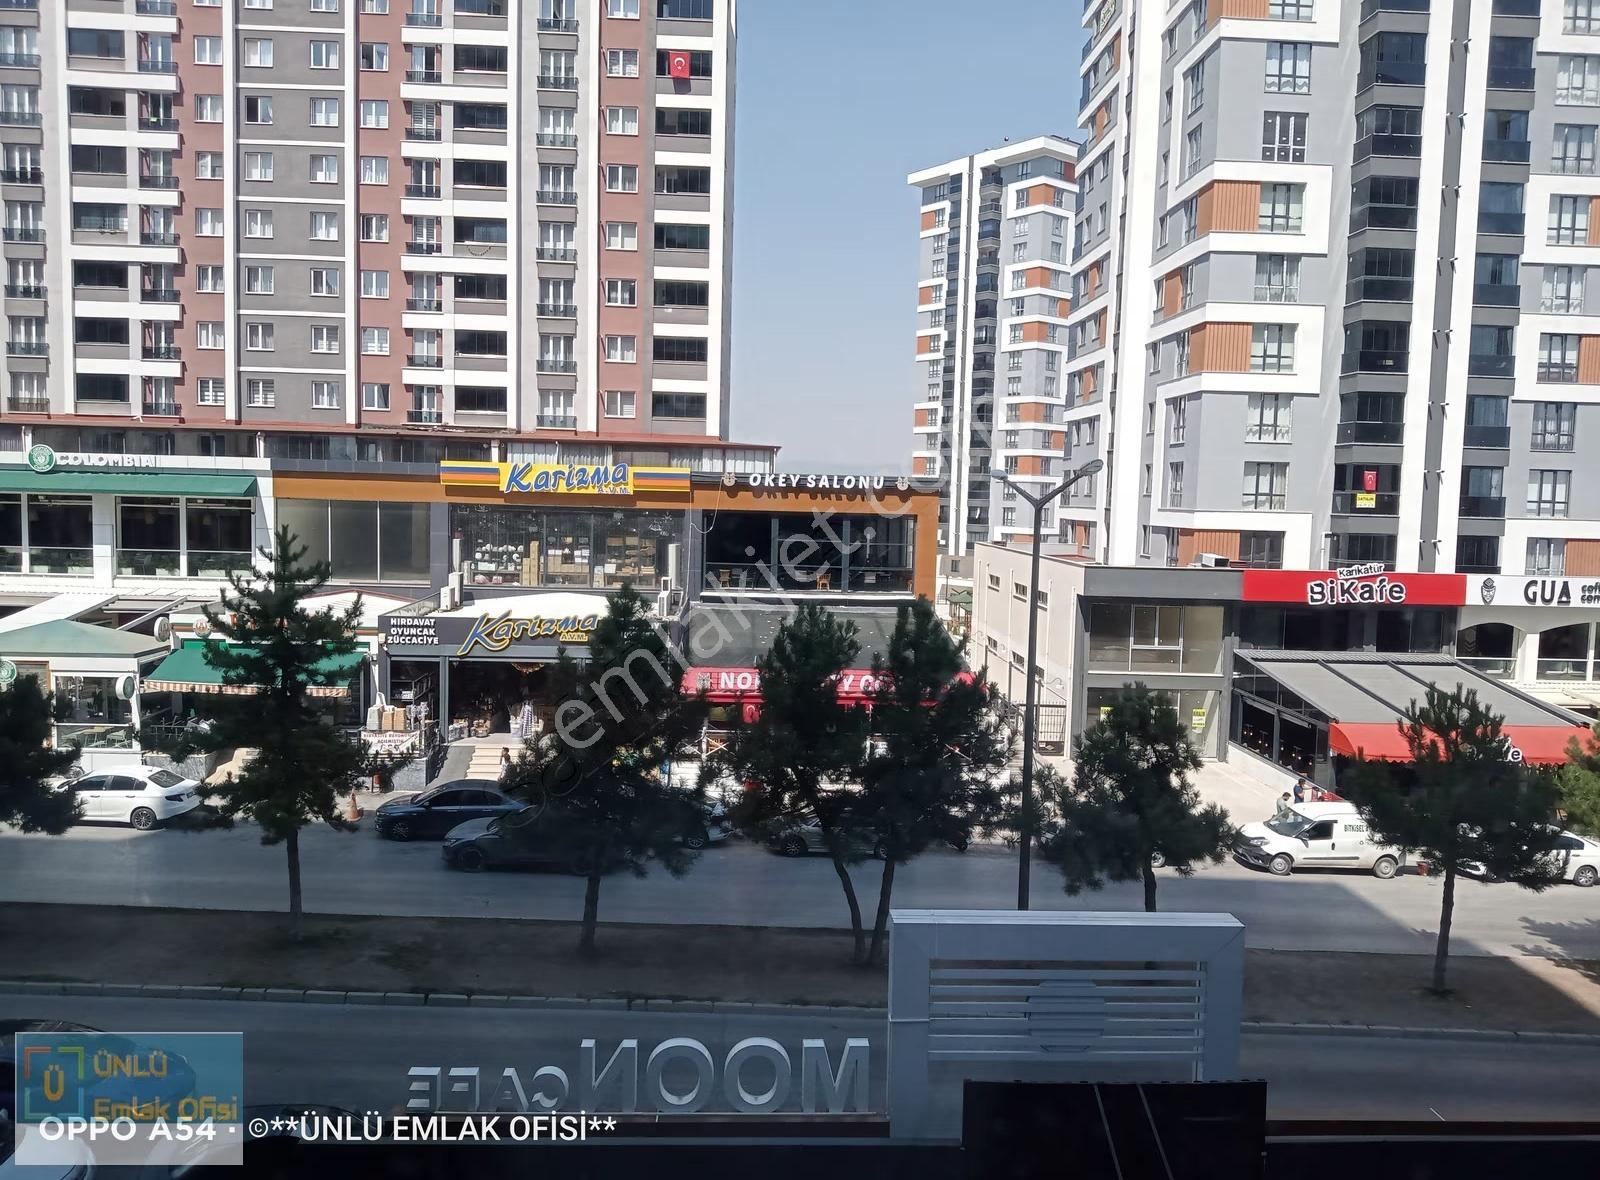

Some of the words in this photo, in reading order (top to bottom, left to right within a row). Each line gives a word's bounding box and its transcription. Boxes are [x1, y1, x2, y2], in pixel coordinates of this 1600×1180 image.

[504, 462, 629, 494] Karizma
[749, 473, 800, 488] OKEY
[806, 475, 885, 490] SALONU
[1338, 564, 1384, 578] Karikatür
[1308, 577, 1406, 604] BiKafe
[1524, 580, 1571, 606] GUA
[390, 618, 436, 626] HIRDAVAT
[387, 635, 439, 645] ZÜCCACİYE
[390, 627, 436, 636] OYUNCAK
[456, 609, 600, 656] Karizma
